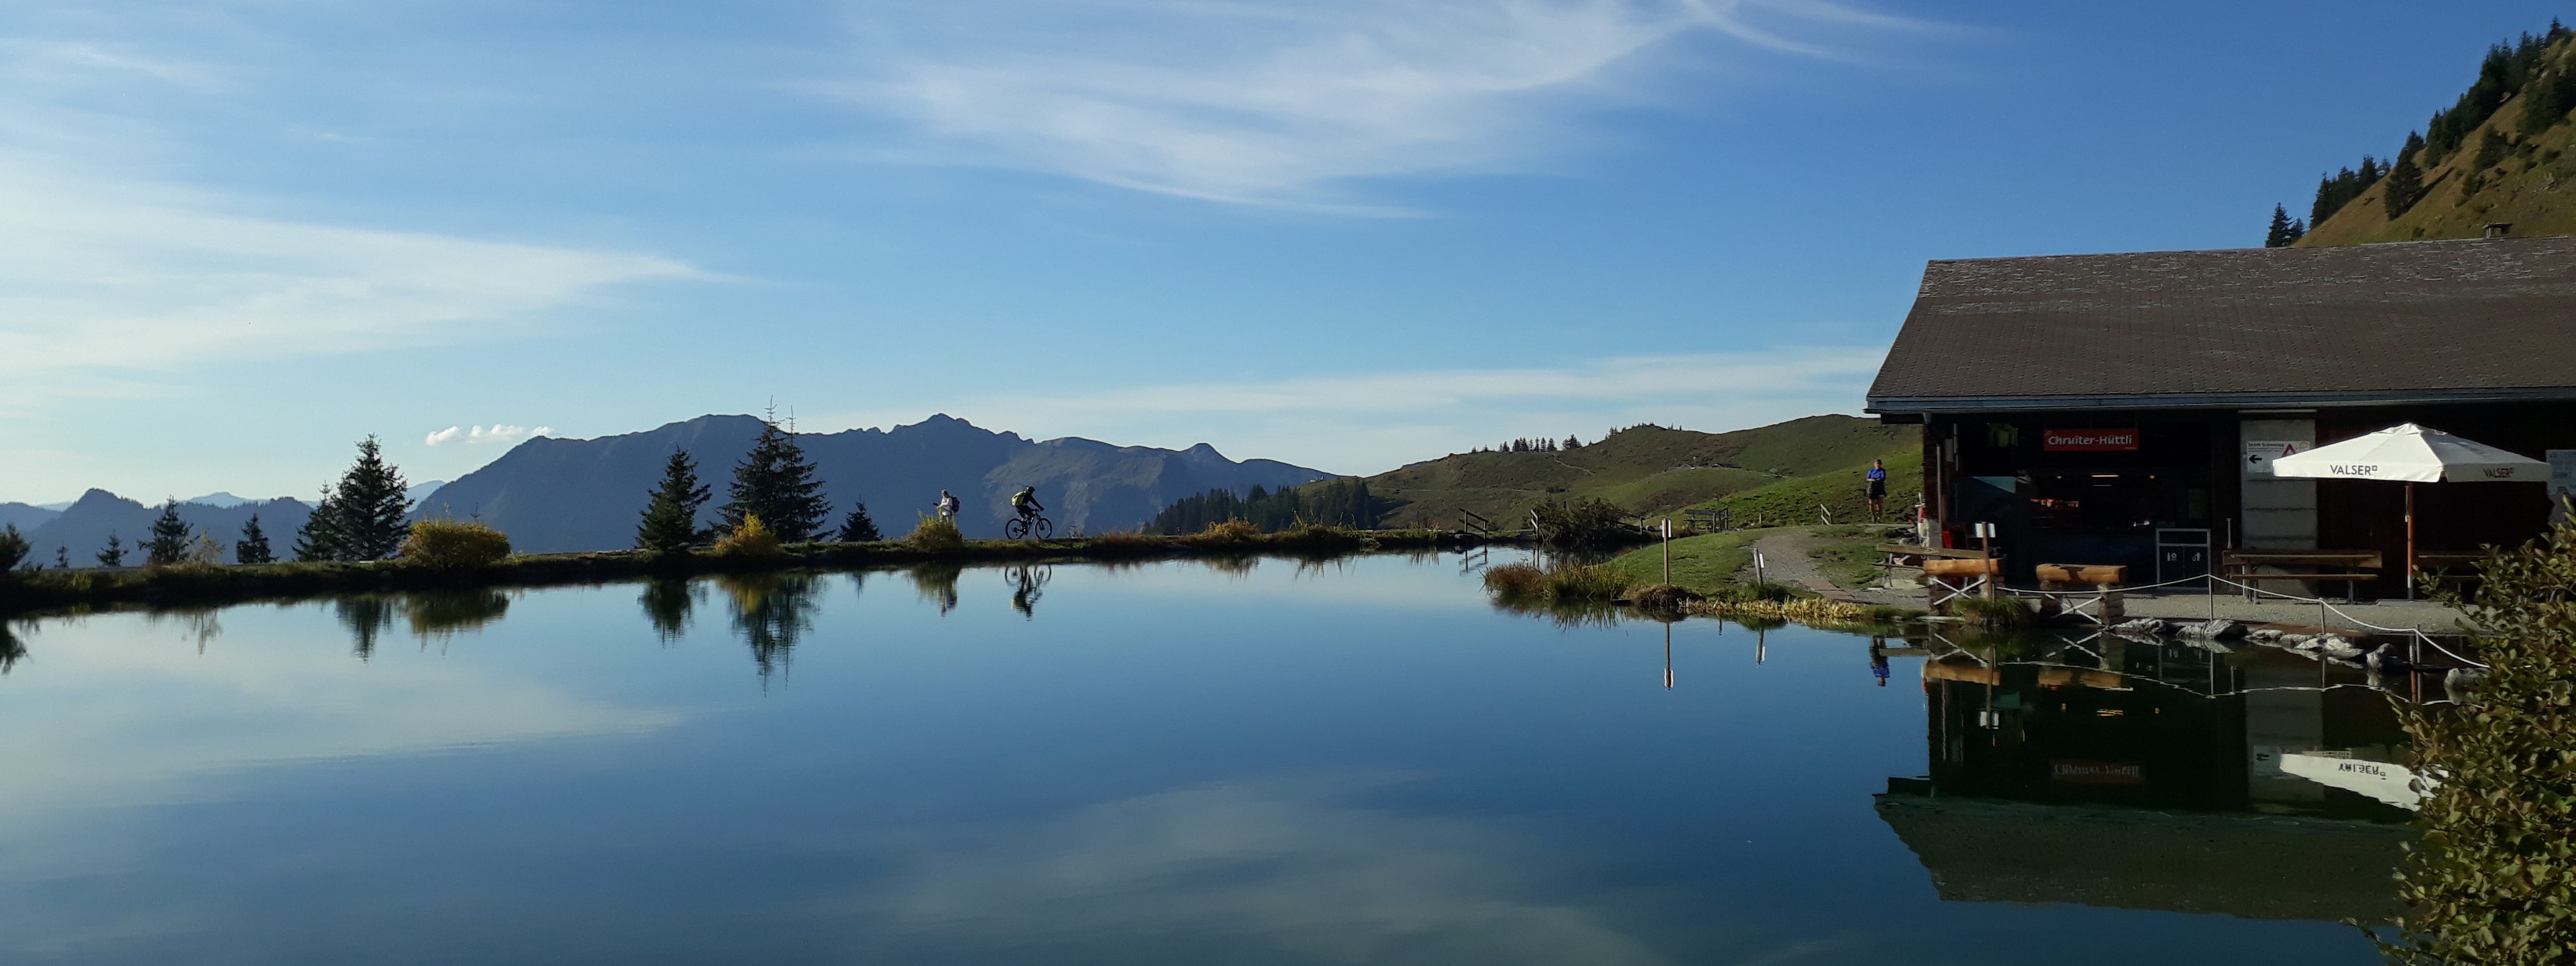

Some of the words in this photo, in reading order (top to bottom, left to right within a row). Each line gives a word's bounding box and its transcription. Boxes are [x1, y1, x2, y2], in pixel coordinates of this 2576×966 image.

[2048, 434, 2132, 445] Chruiter-Hüttli
[2330, 464, 2371, 476] VALSER
[2483, 467, 2512, 478] VALSER
